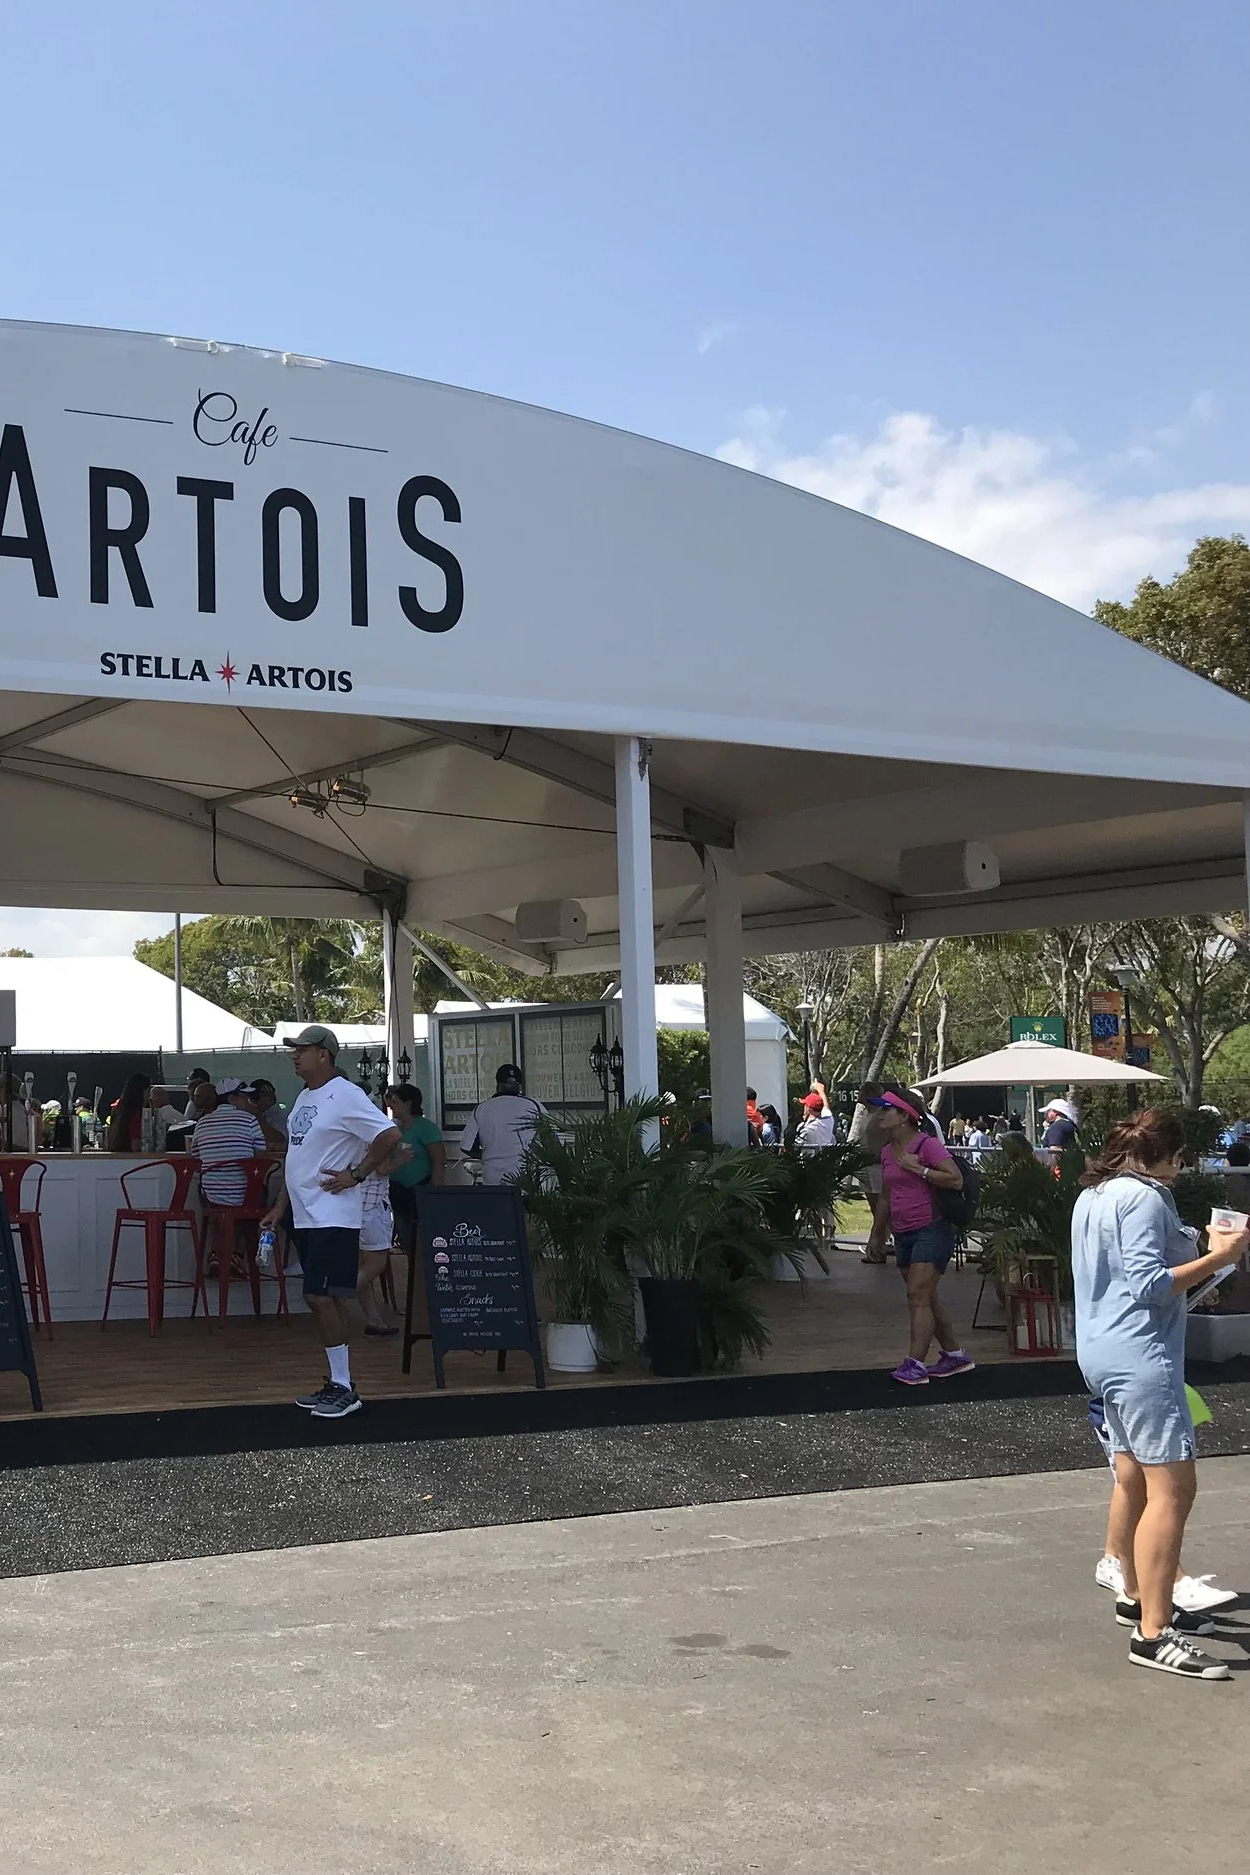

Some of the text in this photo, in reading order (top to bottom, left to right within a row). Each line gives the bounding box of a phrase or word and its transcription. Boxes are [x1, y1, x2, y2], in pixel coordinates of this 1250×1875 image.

[192, 387, 278, 466] Cafe
[100, 652, 353, 693] STELLA ARTOIS
[444, 1026, 510, 1049] STELLA
[1019, 1032, 1058, 1041] ROLEX
[837, 1089, 860, 1102] 16 15
[459, 1293, 494, 1306] Snacks
